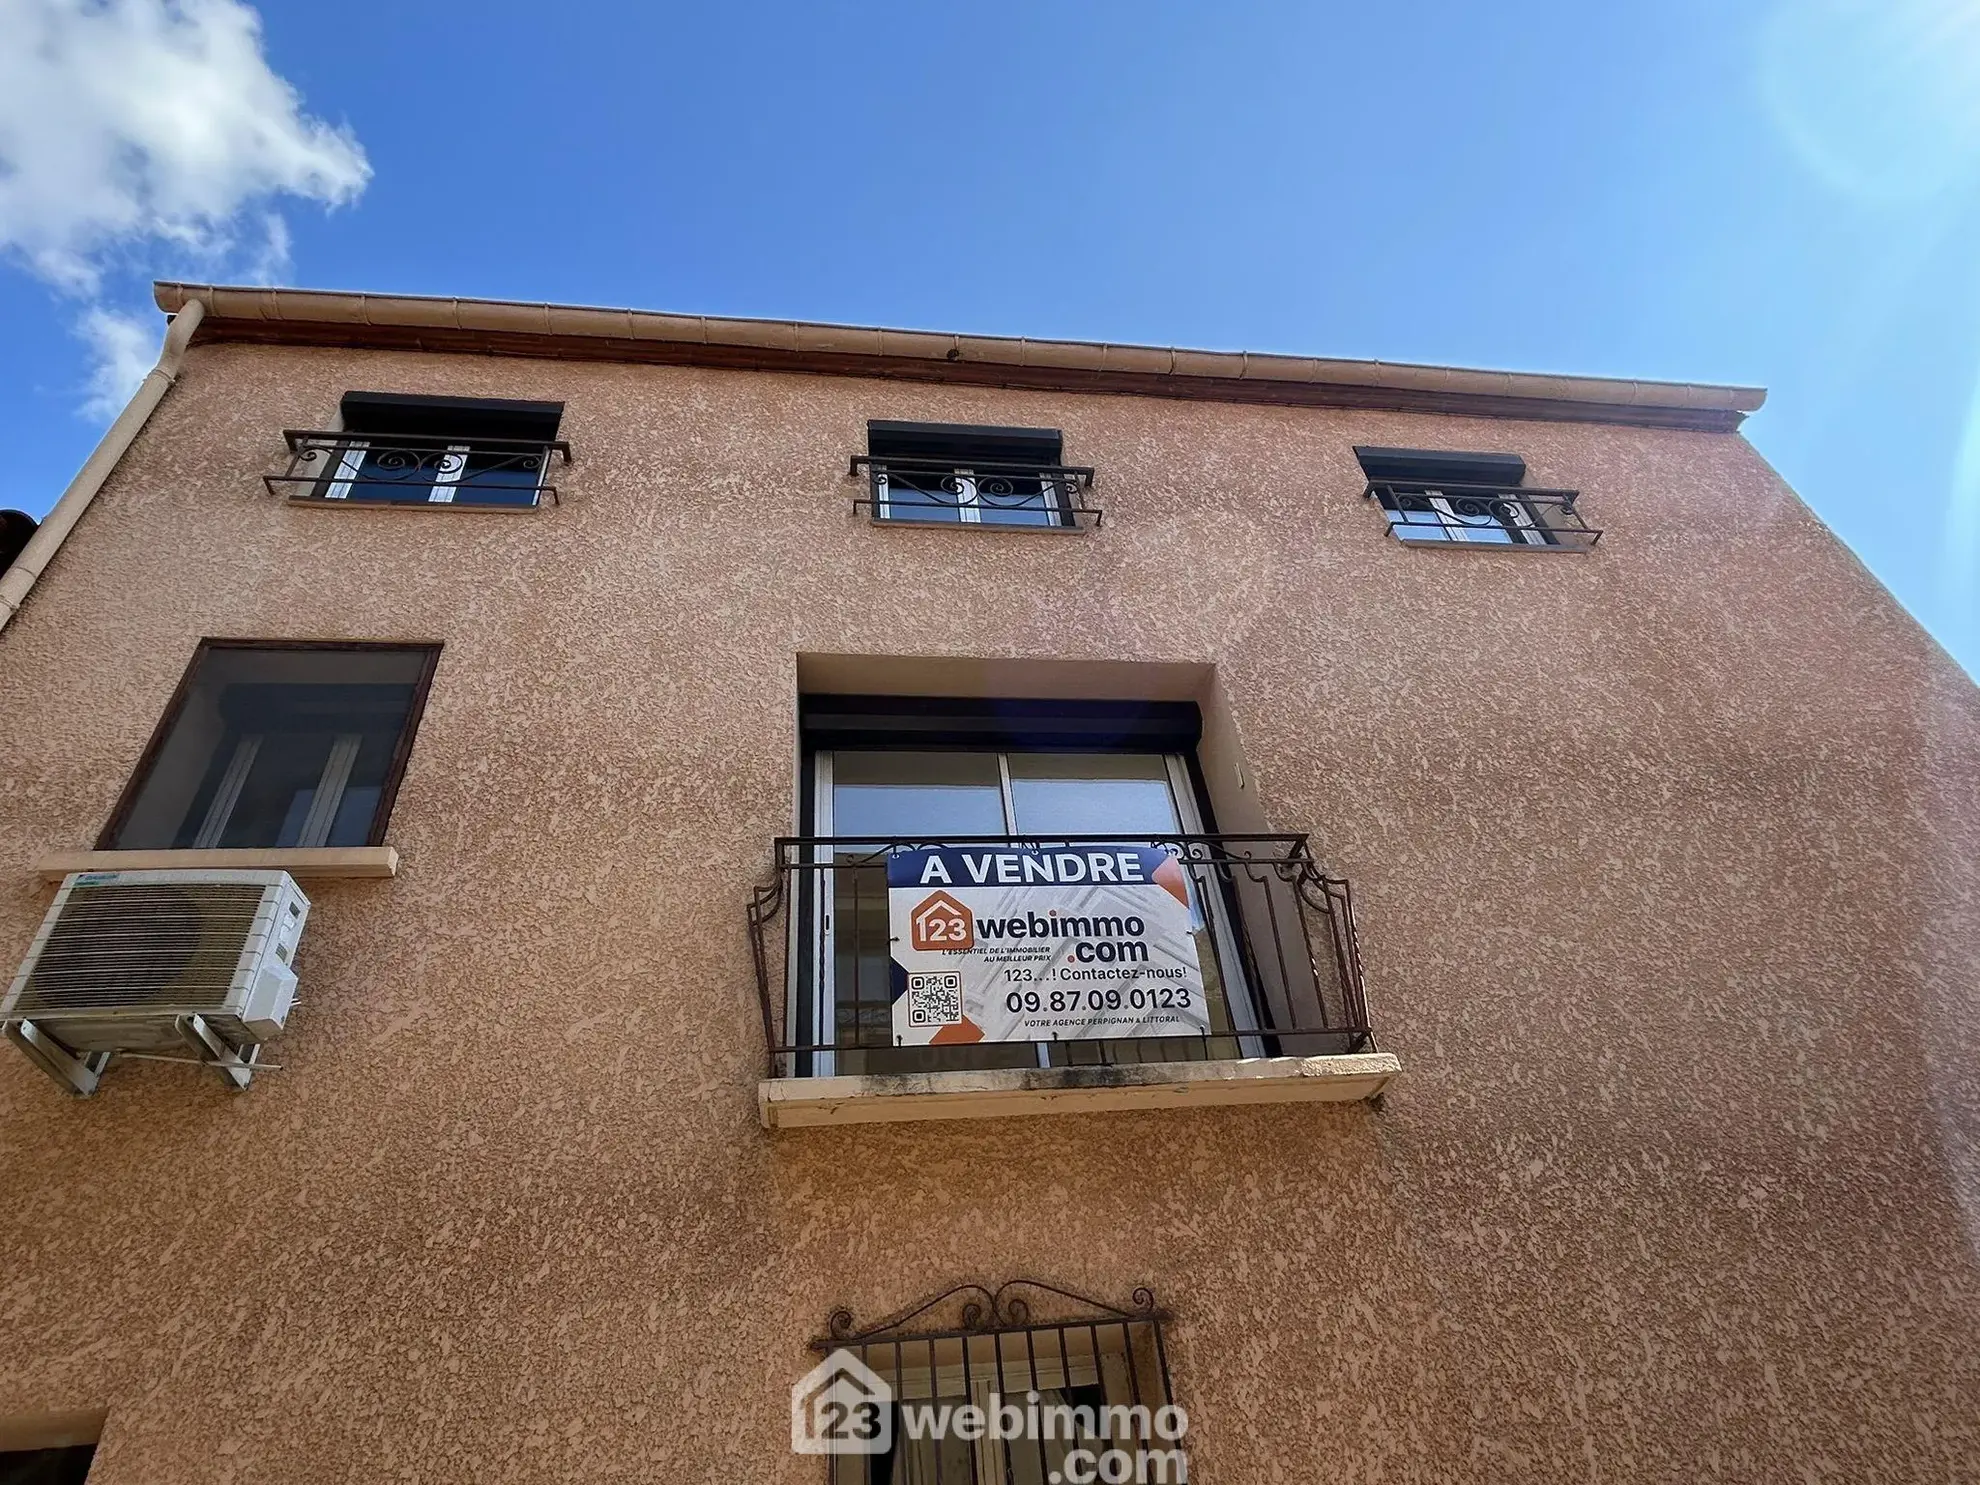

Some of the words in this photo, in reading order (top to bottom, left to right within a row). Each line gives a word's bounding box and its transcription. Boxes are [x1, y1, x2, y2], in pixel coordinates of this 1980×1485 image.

[920, 855, 952, 884] A
[961, 852, 1145, 884] VENDRE
[915, 917, 967, 942] 123
[977, 910, 1145, 939] webimmo
[942, 947, 988, 955] L'ESSENTIEL
[1000, 946, 1051, 954] L'IMMOBILIER
[1067, 940, 1149, 963] .com
[1060, 966, 1188, 981] Contactez-nous!
[1006, 987, 1192, 1013] 09.87.09.0123
[1024, 1019, 1050, 1027] VOTRE
[1052, 1018, 1086, 1026] AGENCE
[1087, 1016, 1134, 1025] PERPIGNAN
[1142, 1015, 1180, 1024] LITTORAL
